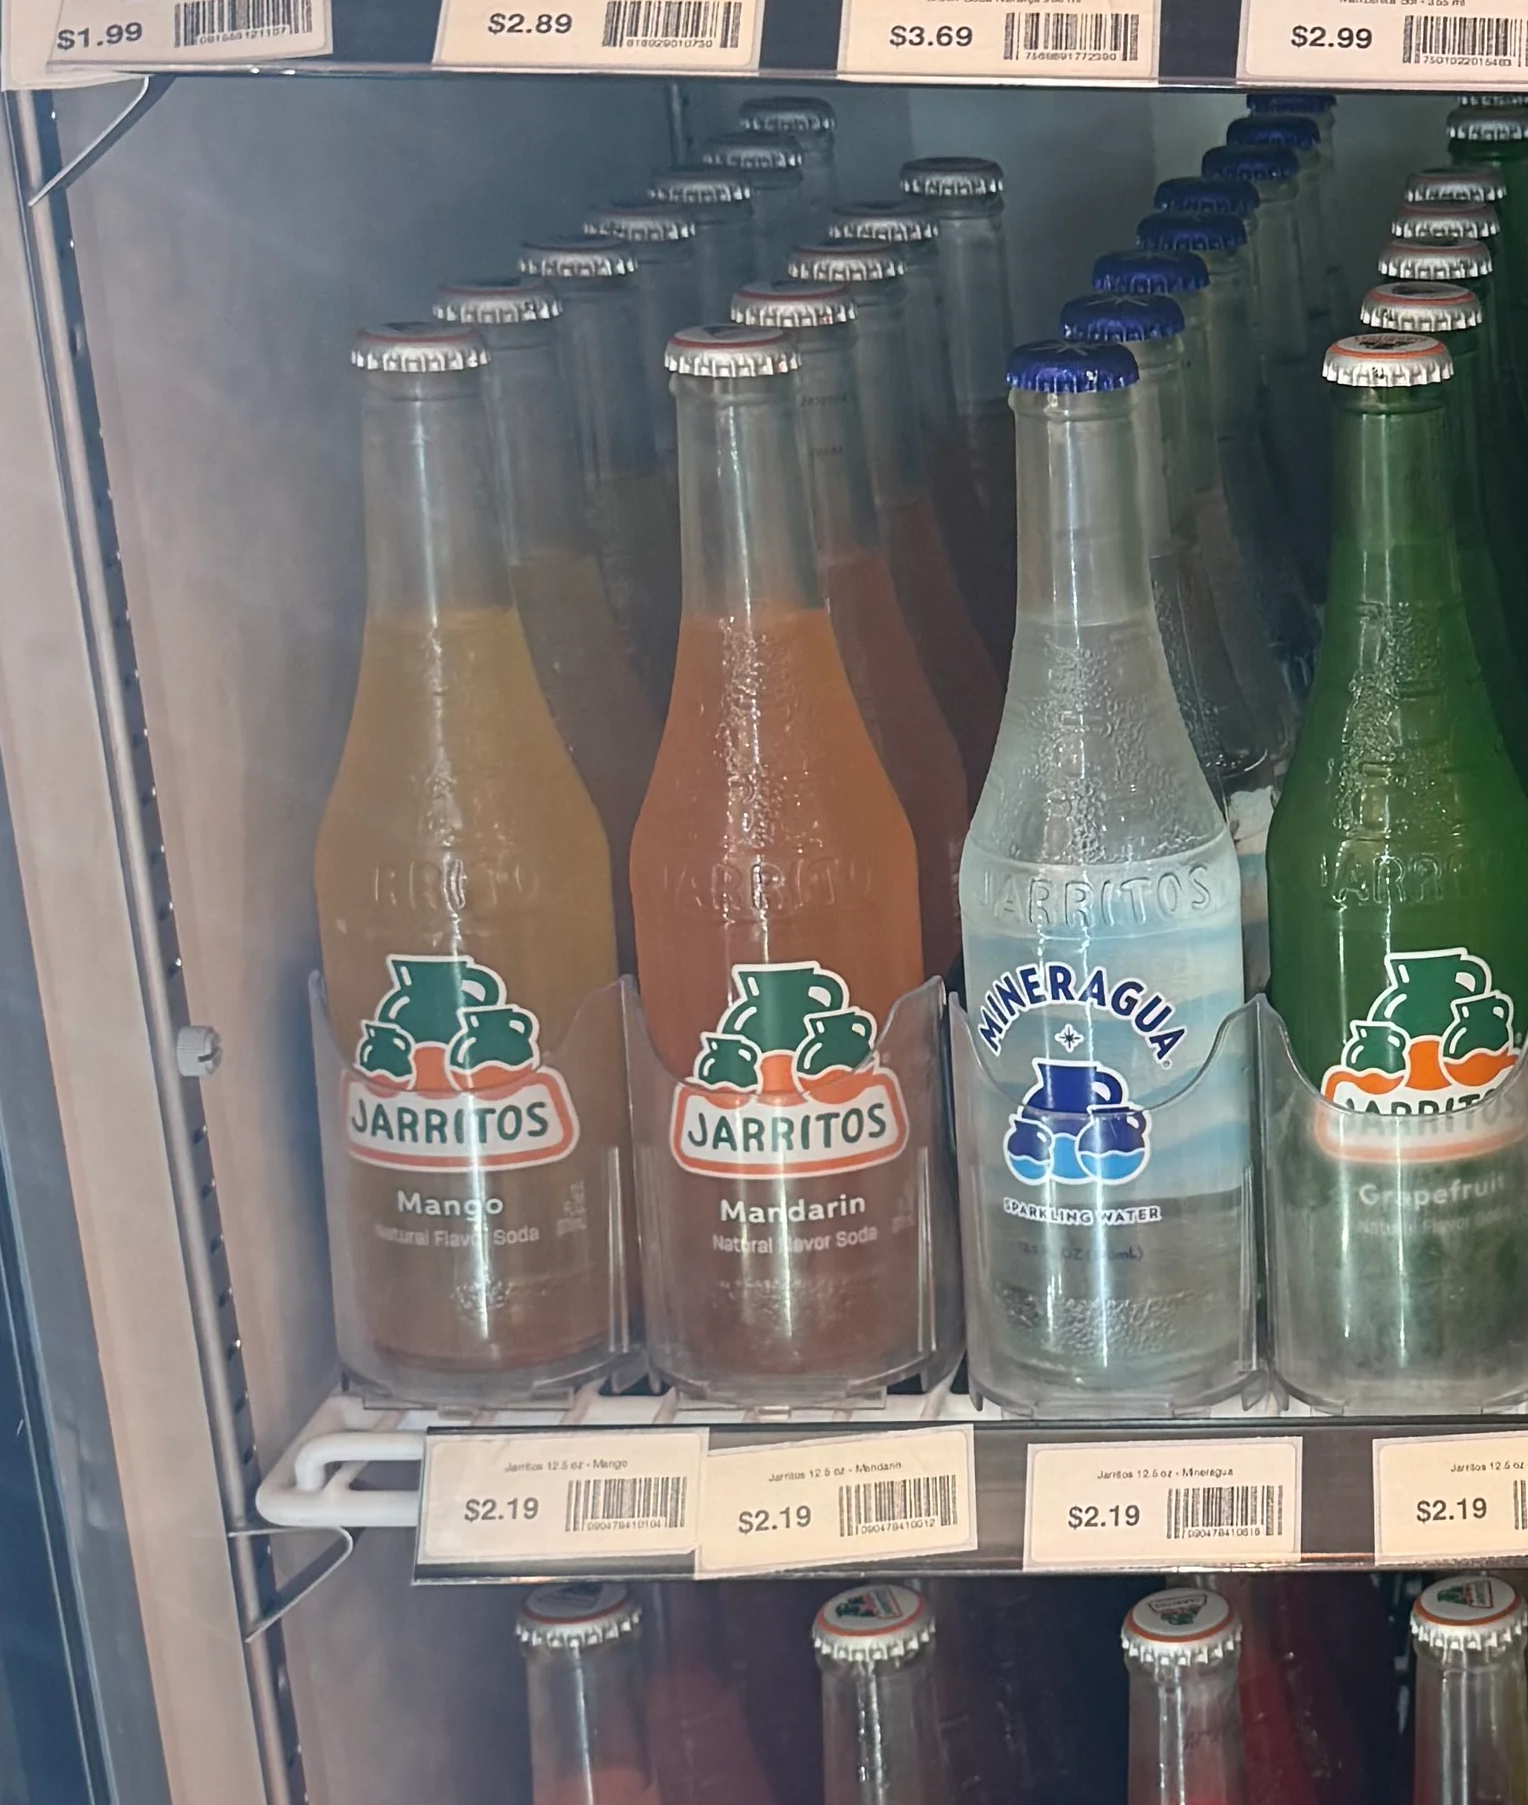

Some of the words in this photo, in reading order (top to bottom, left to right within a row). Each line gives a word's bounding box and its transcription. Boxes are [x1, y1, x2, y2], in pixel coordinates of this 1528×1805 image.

[56, 21, 143, 51] $1.99
[488, 12, 574, 36] $2.89
[889, 25, 973, 49] $3.69
[1290, 25, 1373, 49] $2.99
[977, 962, 1187, 1057] MINERAGUA
[352, 1098, 550, 1145] JARRITOS
[687, 1101, 888, 1154] JARRITOS
[397, 1189, 504, 1222] Mango
[1358, 1175, 1505, 1214] Grapefruit
[720, 1194, 866, 1226] Mandarin
[1004, 1198, 1092, 1225] SPARKLING
[1097, 1205, 1163, 1226] WATER
[493, 1225, 540, 1247] Soda
[593, 1458, 629, 1471] Mango
[464, 1497, 539, 1524] $2.19
[738, 1505, 812, 1535] $2.19
[1068, 1504, 1141, 1530] $2.19
[1416, 1496, 1488, 1525] $2.19
